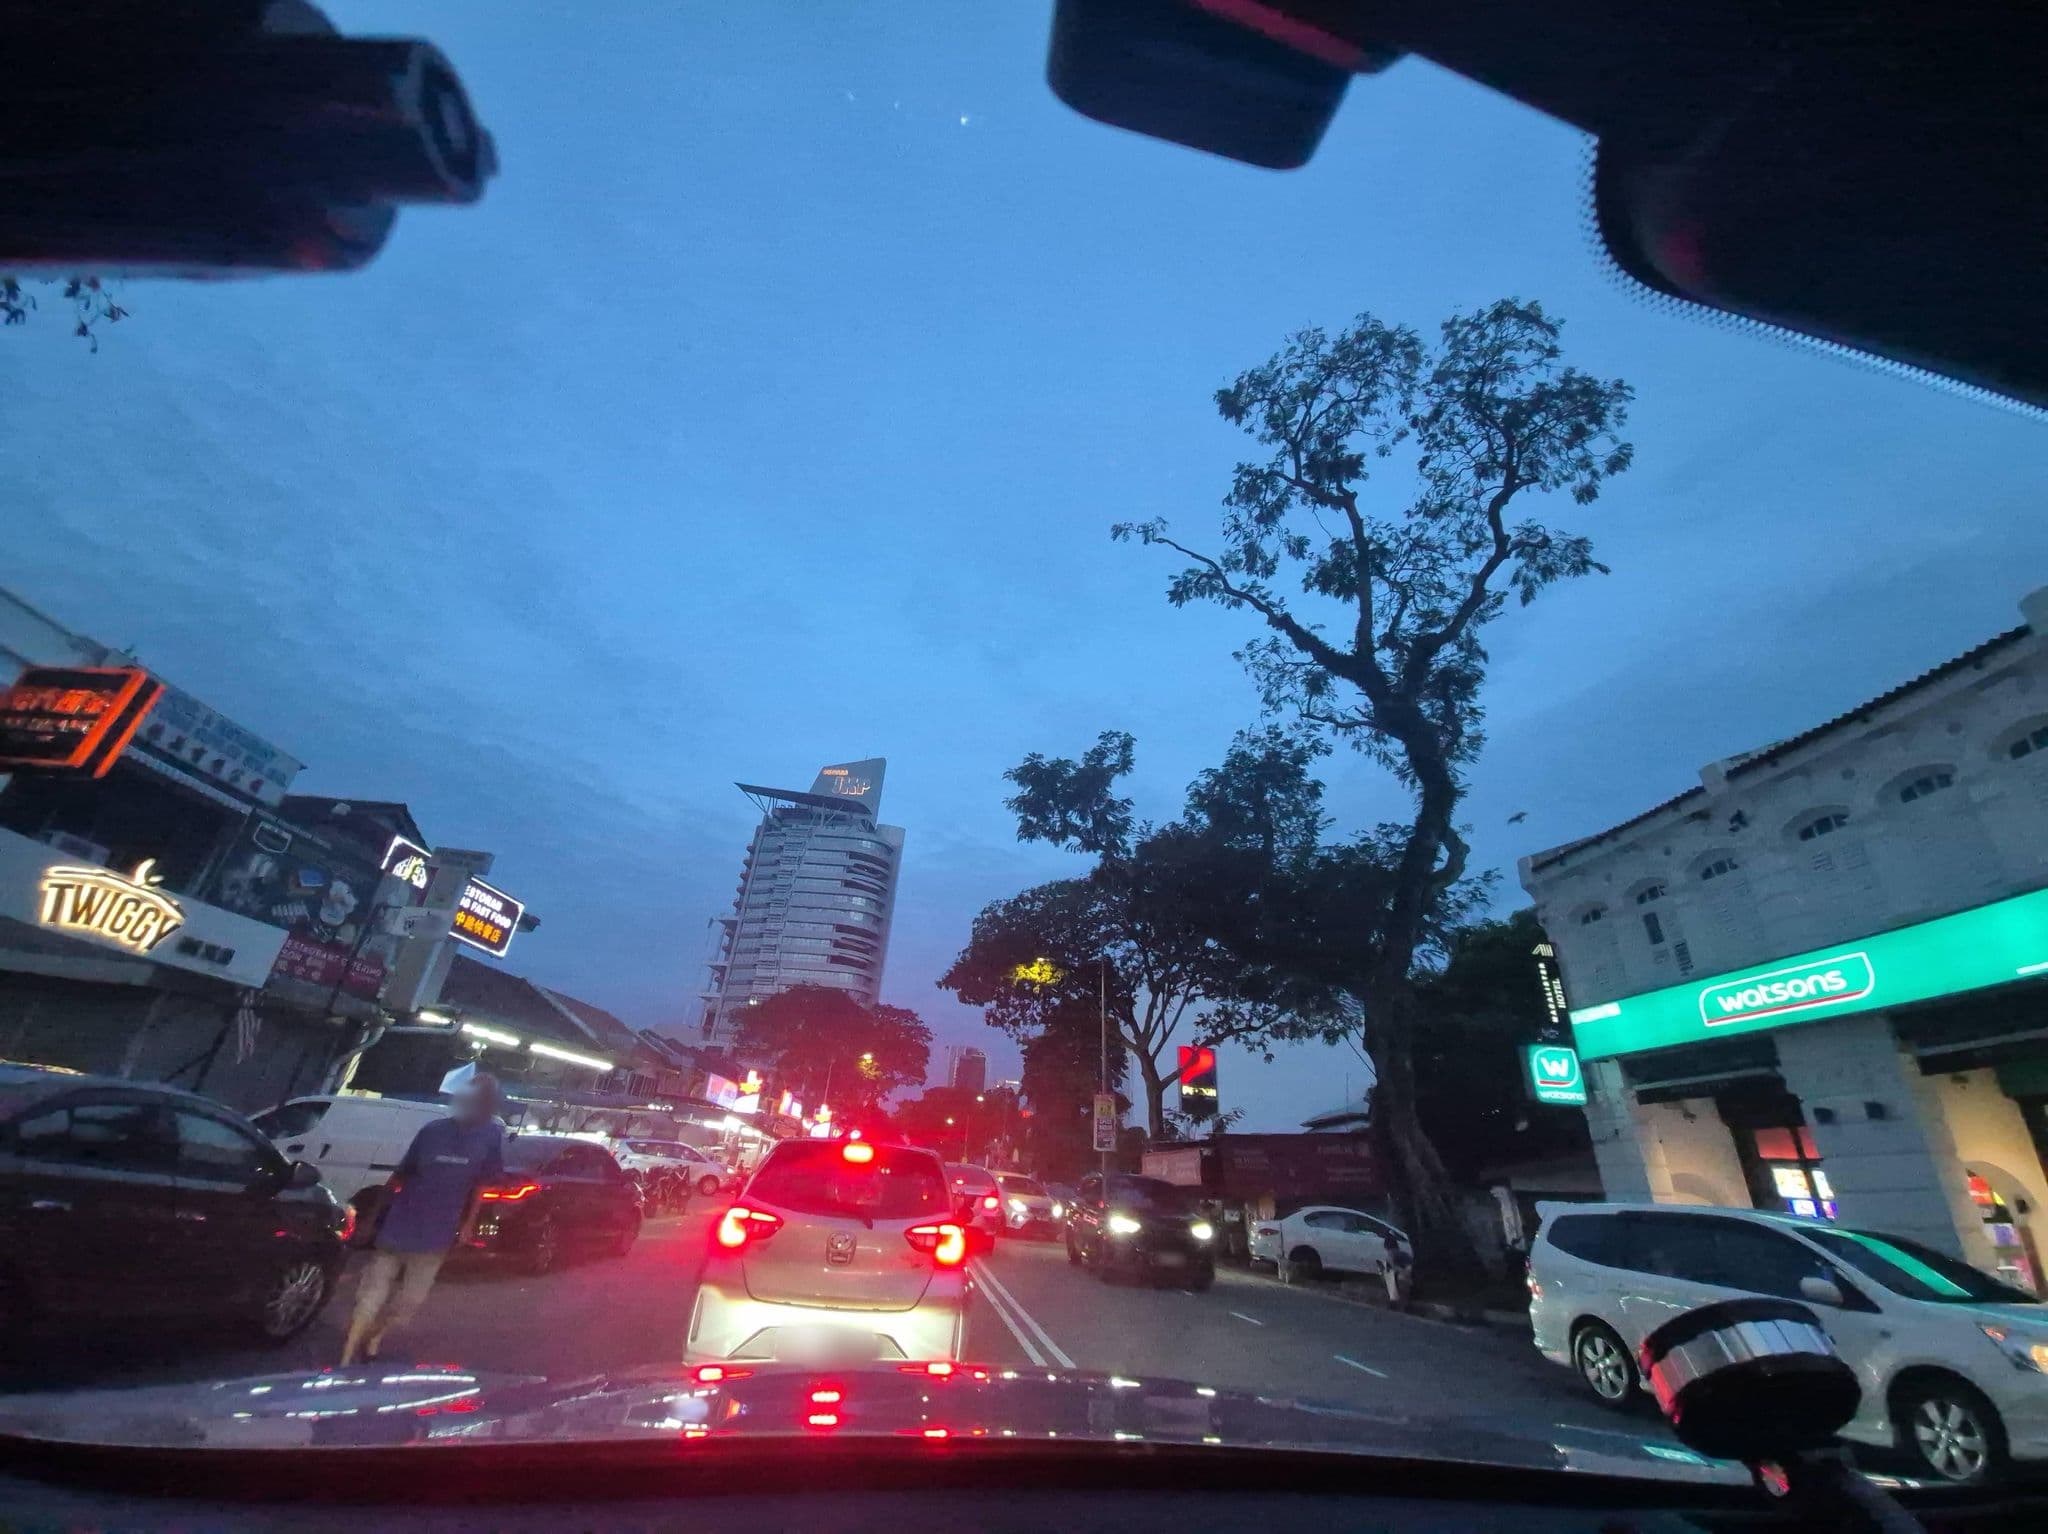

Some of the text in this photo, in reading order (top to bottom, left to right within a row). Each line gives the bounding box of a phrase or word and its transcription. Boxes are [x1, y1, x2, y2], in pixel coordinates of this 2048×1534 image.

[44, 880, 181, 951] TWIGGY
[470, 901, 491, 919] FAST
[490, 911, 512, 929] FOOD
[1552, 978, 1566, 1009] HOTEL
[1717, 969, 1848, 1012] watsons
